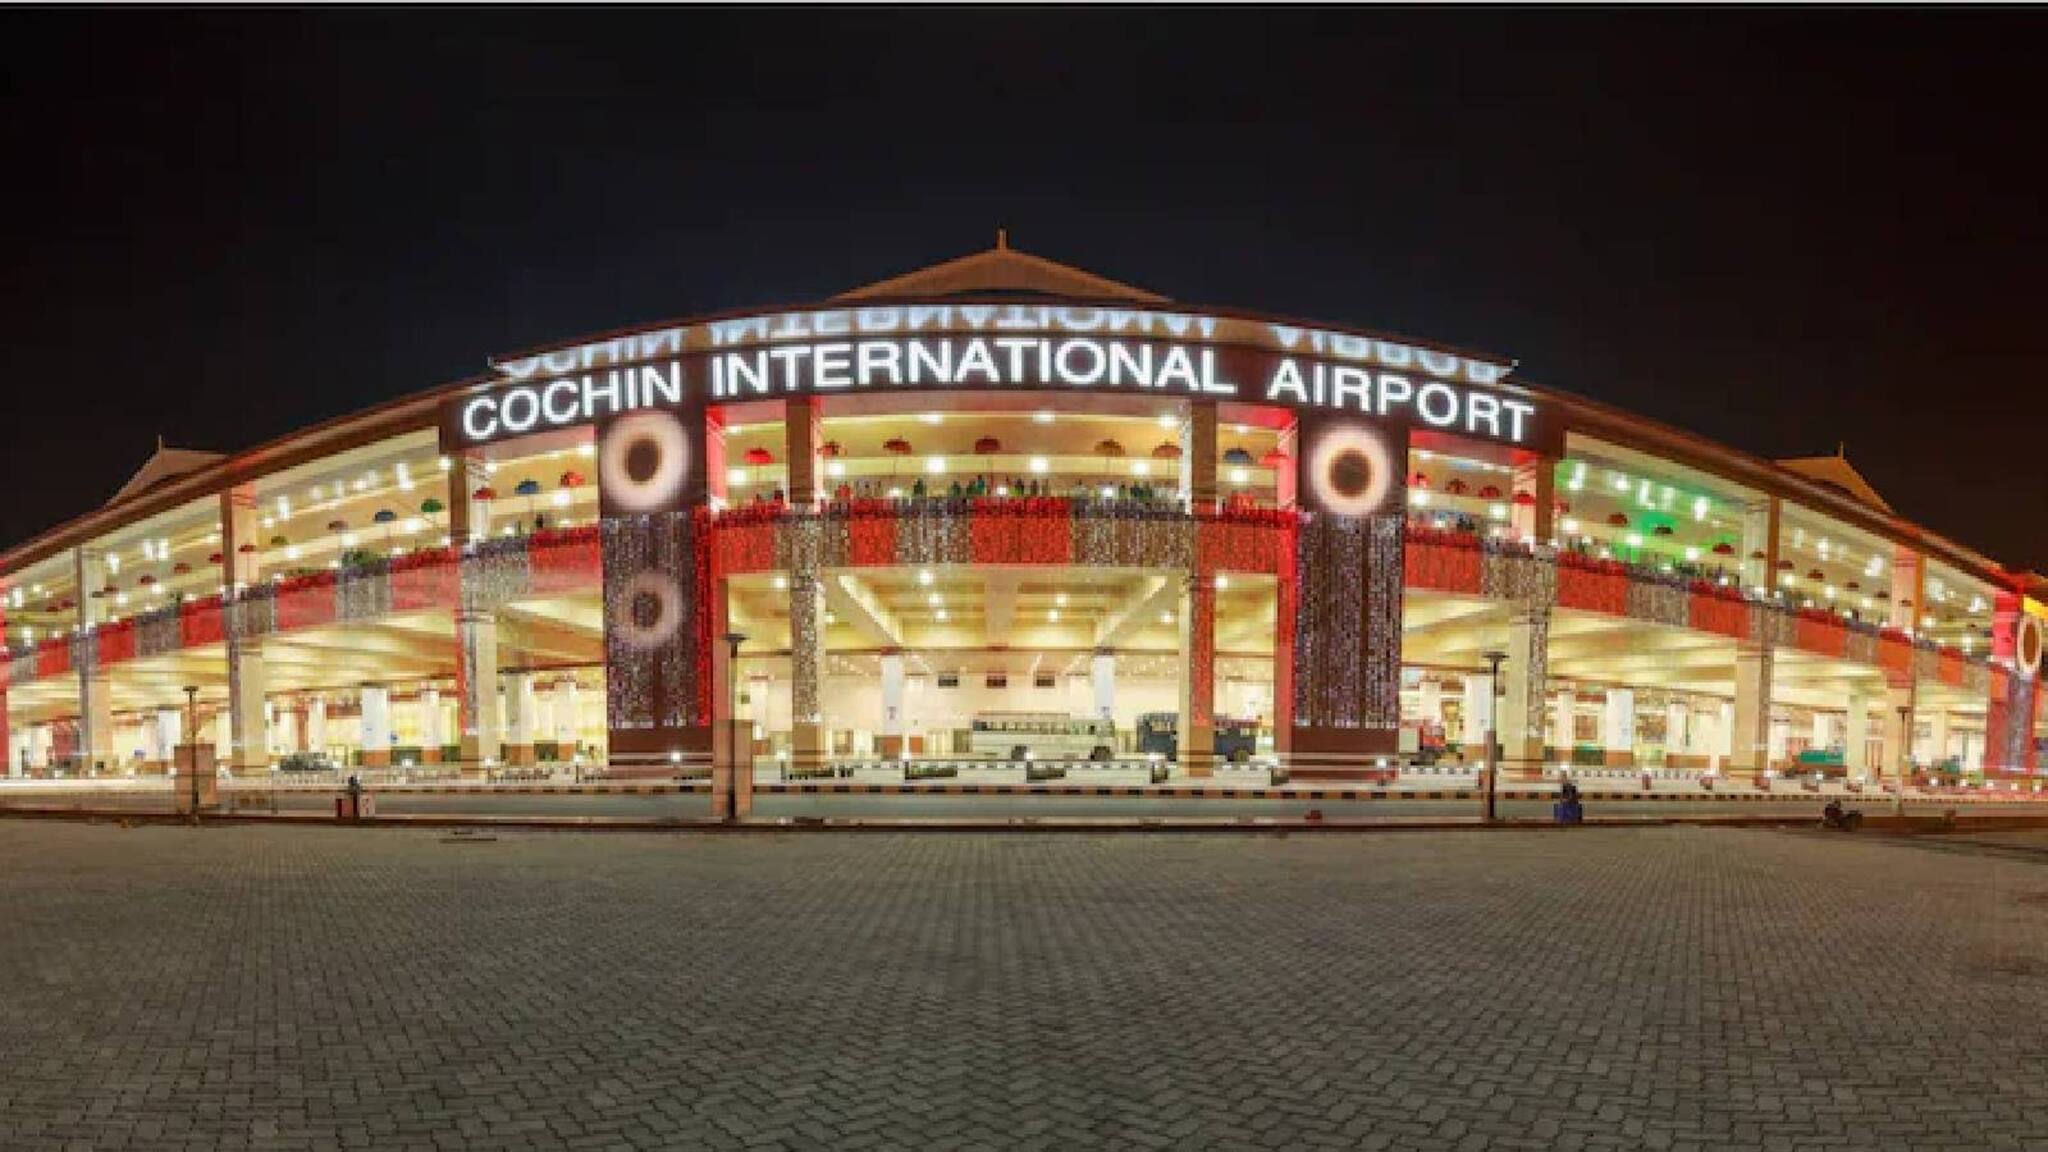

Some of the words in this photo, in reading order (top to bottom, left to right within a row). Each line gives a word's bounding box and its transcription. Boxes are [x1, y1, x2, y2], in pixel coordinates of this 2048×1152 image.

[463, 362, 682, 440] COCHIN
[712, 337, 1236, 396] INTERNATIONAL
[1266, 358, 1535, 442] AIRPORT
